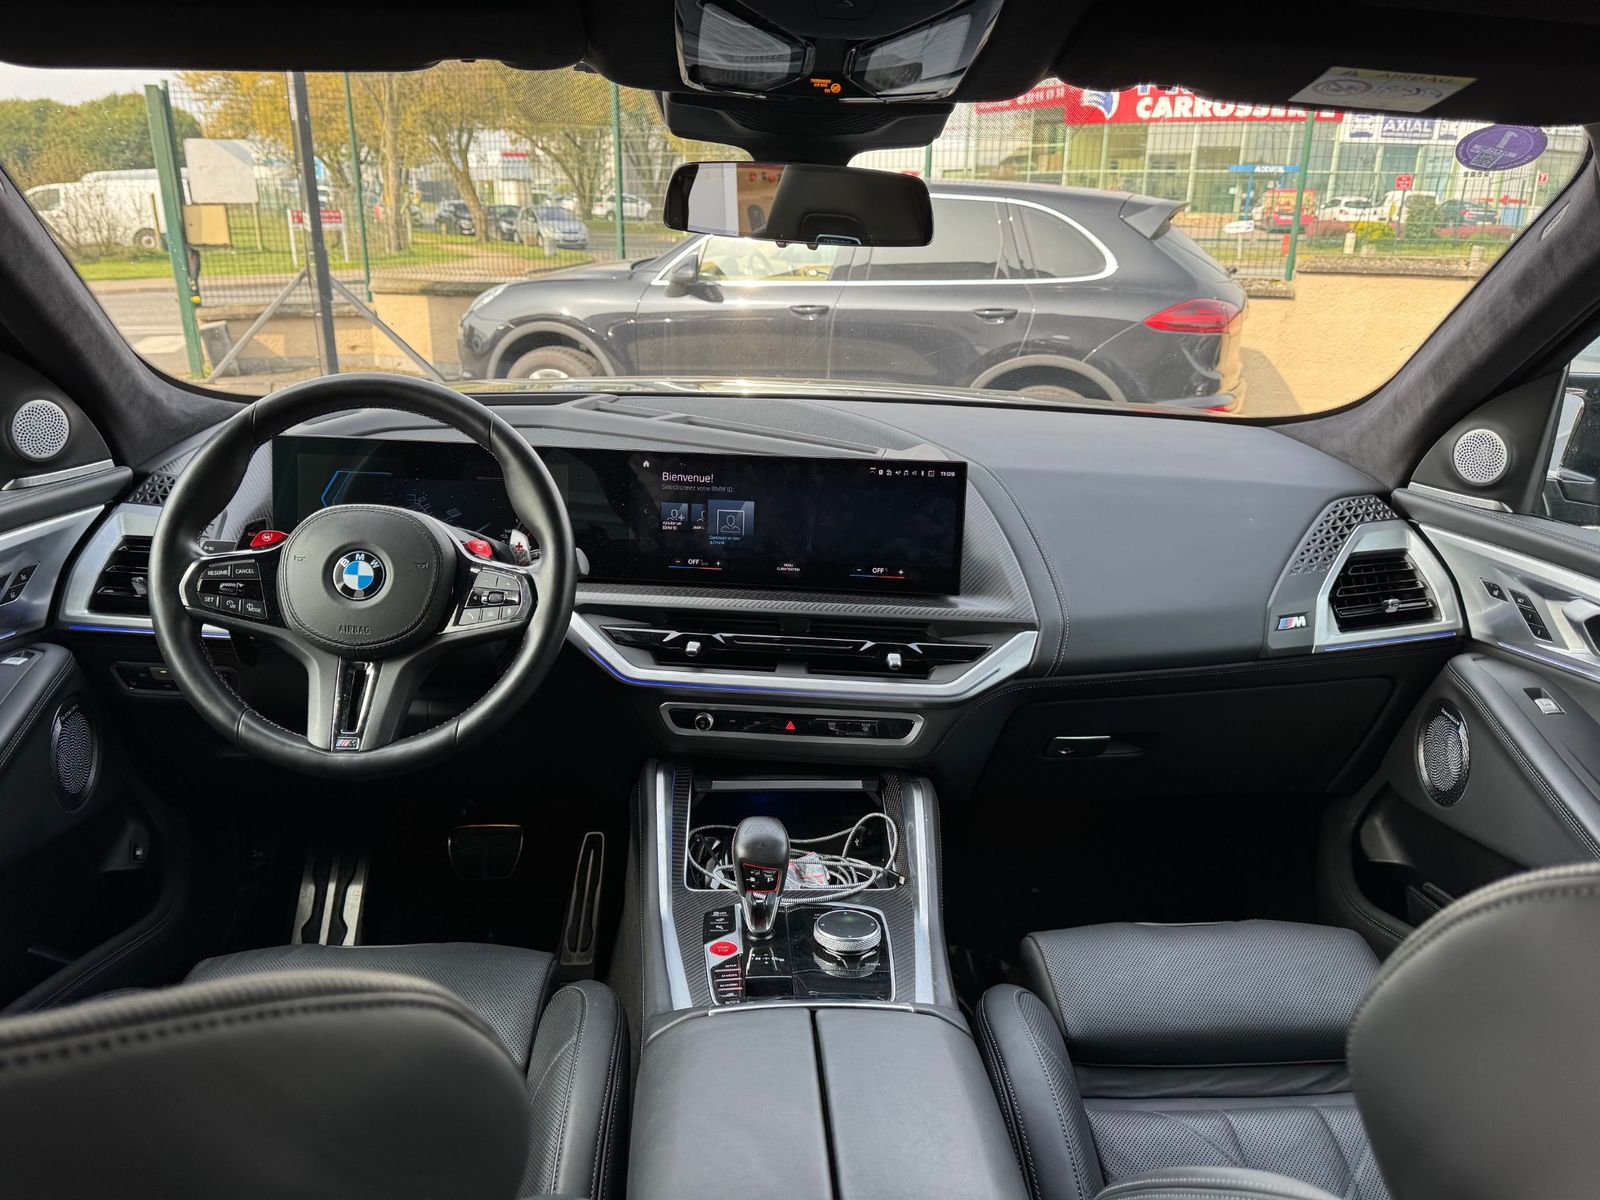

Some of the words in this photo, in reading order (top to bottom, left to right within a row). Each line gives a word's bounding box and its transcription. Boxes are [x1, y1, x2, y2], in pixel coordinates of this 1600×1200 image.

[1376, 71, 1453, 83] AIRBAG
[1136, 97, 1335, 118] CARROSSE
[1383, 119, 1433, 132] AXIAL
[662, 472, 714, 483] Bienvenue!
[339, 553, 381, 568] BMW
[338, 624, 371, 636] AIRBAG
